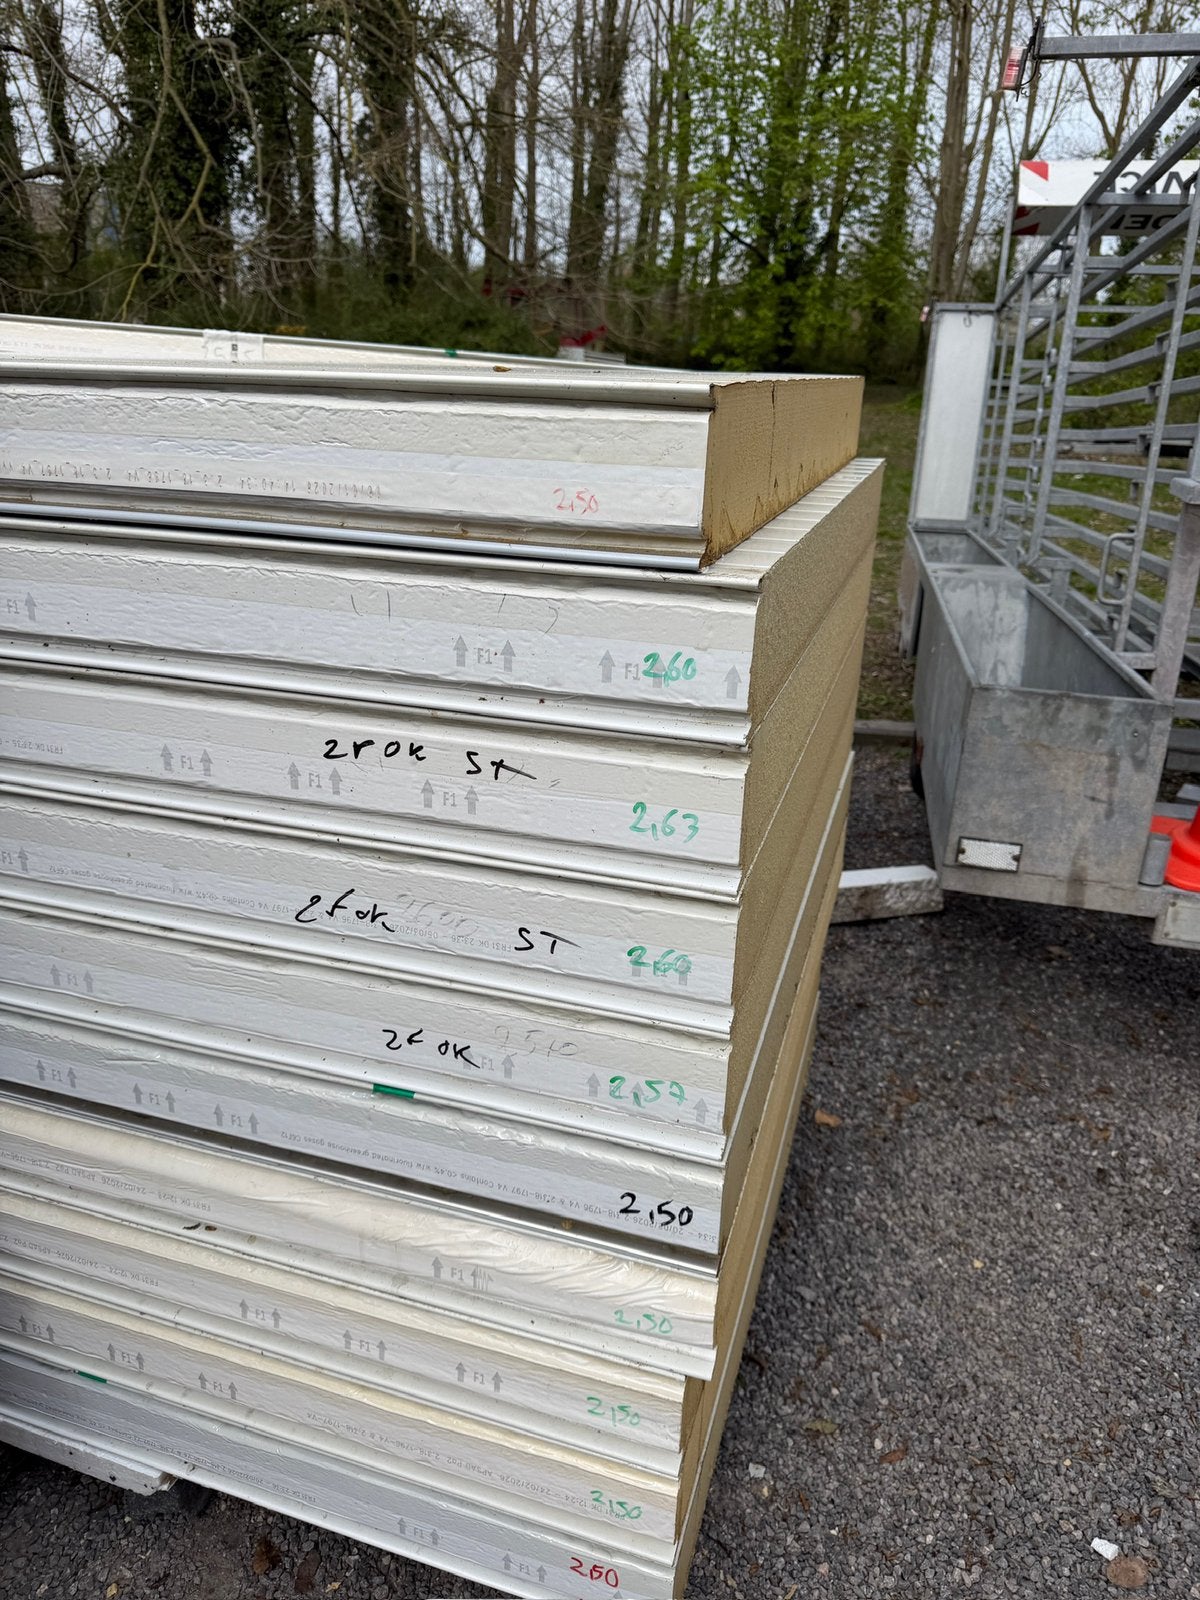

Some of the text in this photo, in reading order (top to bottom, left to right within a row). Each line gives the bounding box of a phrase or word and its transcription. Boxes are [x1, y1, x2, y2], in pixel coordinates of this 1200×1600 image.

[553, 488, 598, 514] 2,50
[7, 599, 20, 615] F1
[477, 648, 492, 665] F1
[625, 662, 640, 681] F1
[642, 651, 697, 687] 2,60
[181, 754, 194, 770] F1
[308, 773, 322, 788] F1
[443, 791, 457, 807] F1
[629, 801, 699, 842] 2,63
[627, 945, 692, 976] 2,60
[67, 972, 78, 986] F1
[481, 1057, 495, 1071] F1
[52, 1070, 63, 1082] F1
[150, 1093, 161, 1106] F1
[609, 1075, 688, 1108] 2,57
[230, 1114, 243, 1127] F1
[302, 1133, 325, 1147] gases
[326, 1138, 370, 1157] greenhouse
[459, 1172, 495, 1188] Contains
[619, 1192, 694, 1227] 2,50
[450, 1268, 463, 1281] F1
[255, 1309, 266, 1321] F1
[614, 1309, 673, 1335] 2,50
[360, 1339, 371, 1351] F1
[121, 1351, 131, 1364] F1
[473, 1372, 485, 1384] F1
[213, 1381, 224, 1393] F1
[587, 1396, 641, 1427] 2,50
[590, 1490, 643, 1520] 2,50
[413, 1527, 425, 1538] F1
[519, 1563, 530, 1575] F1
